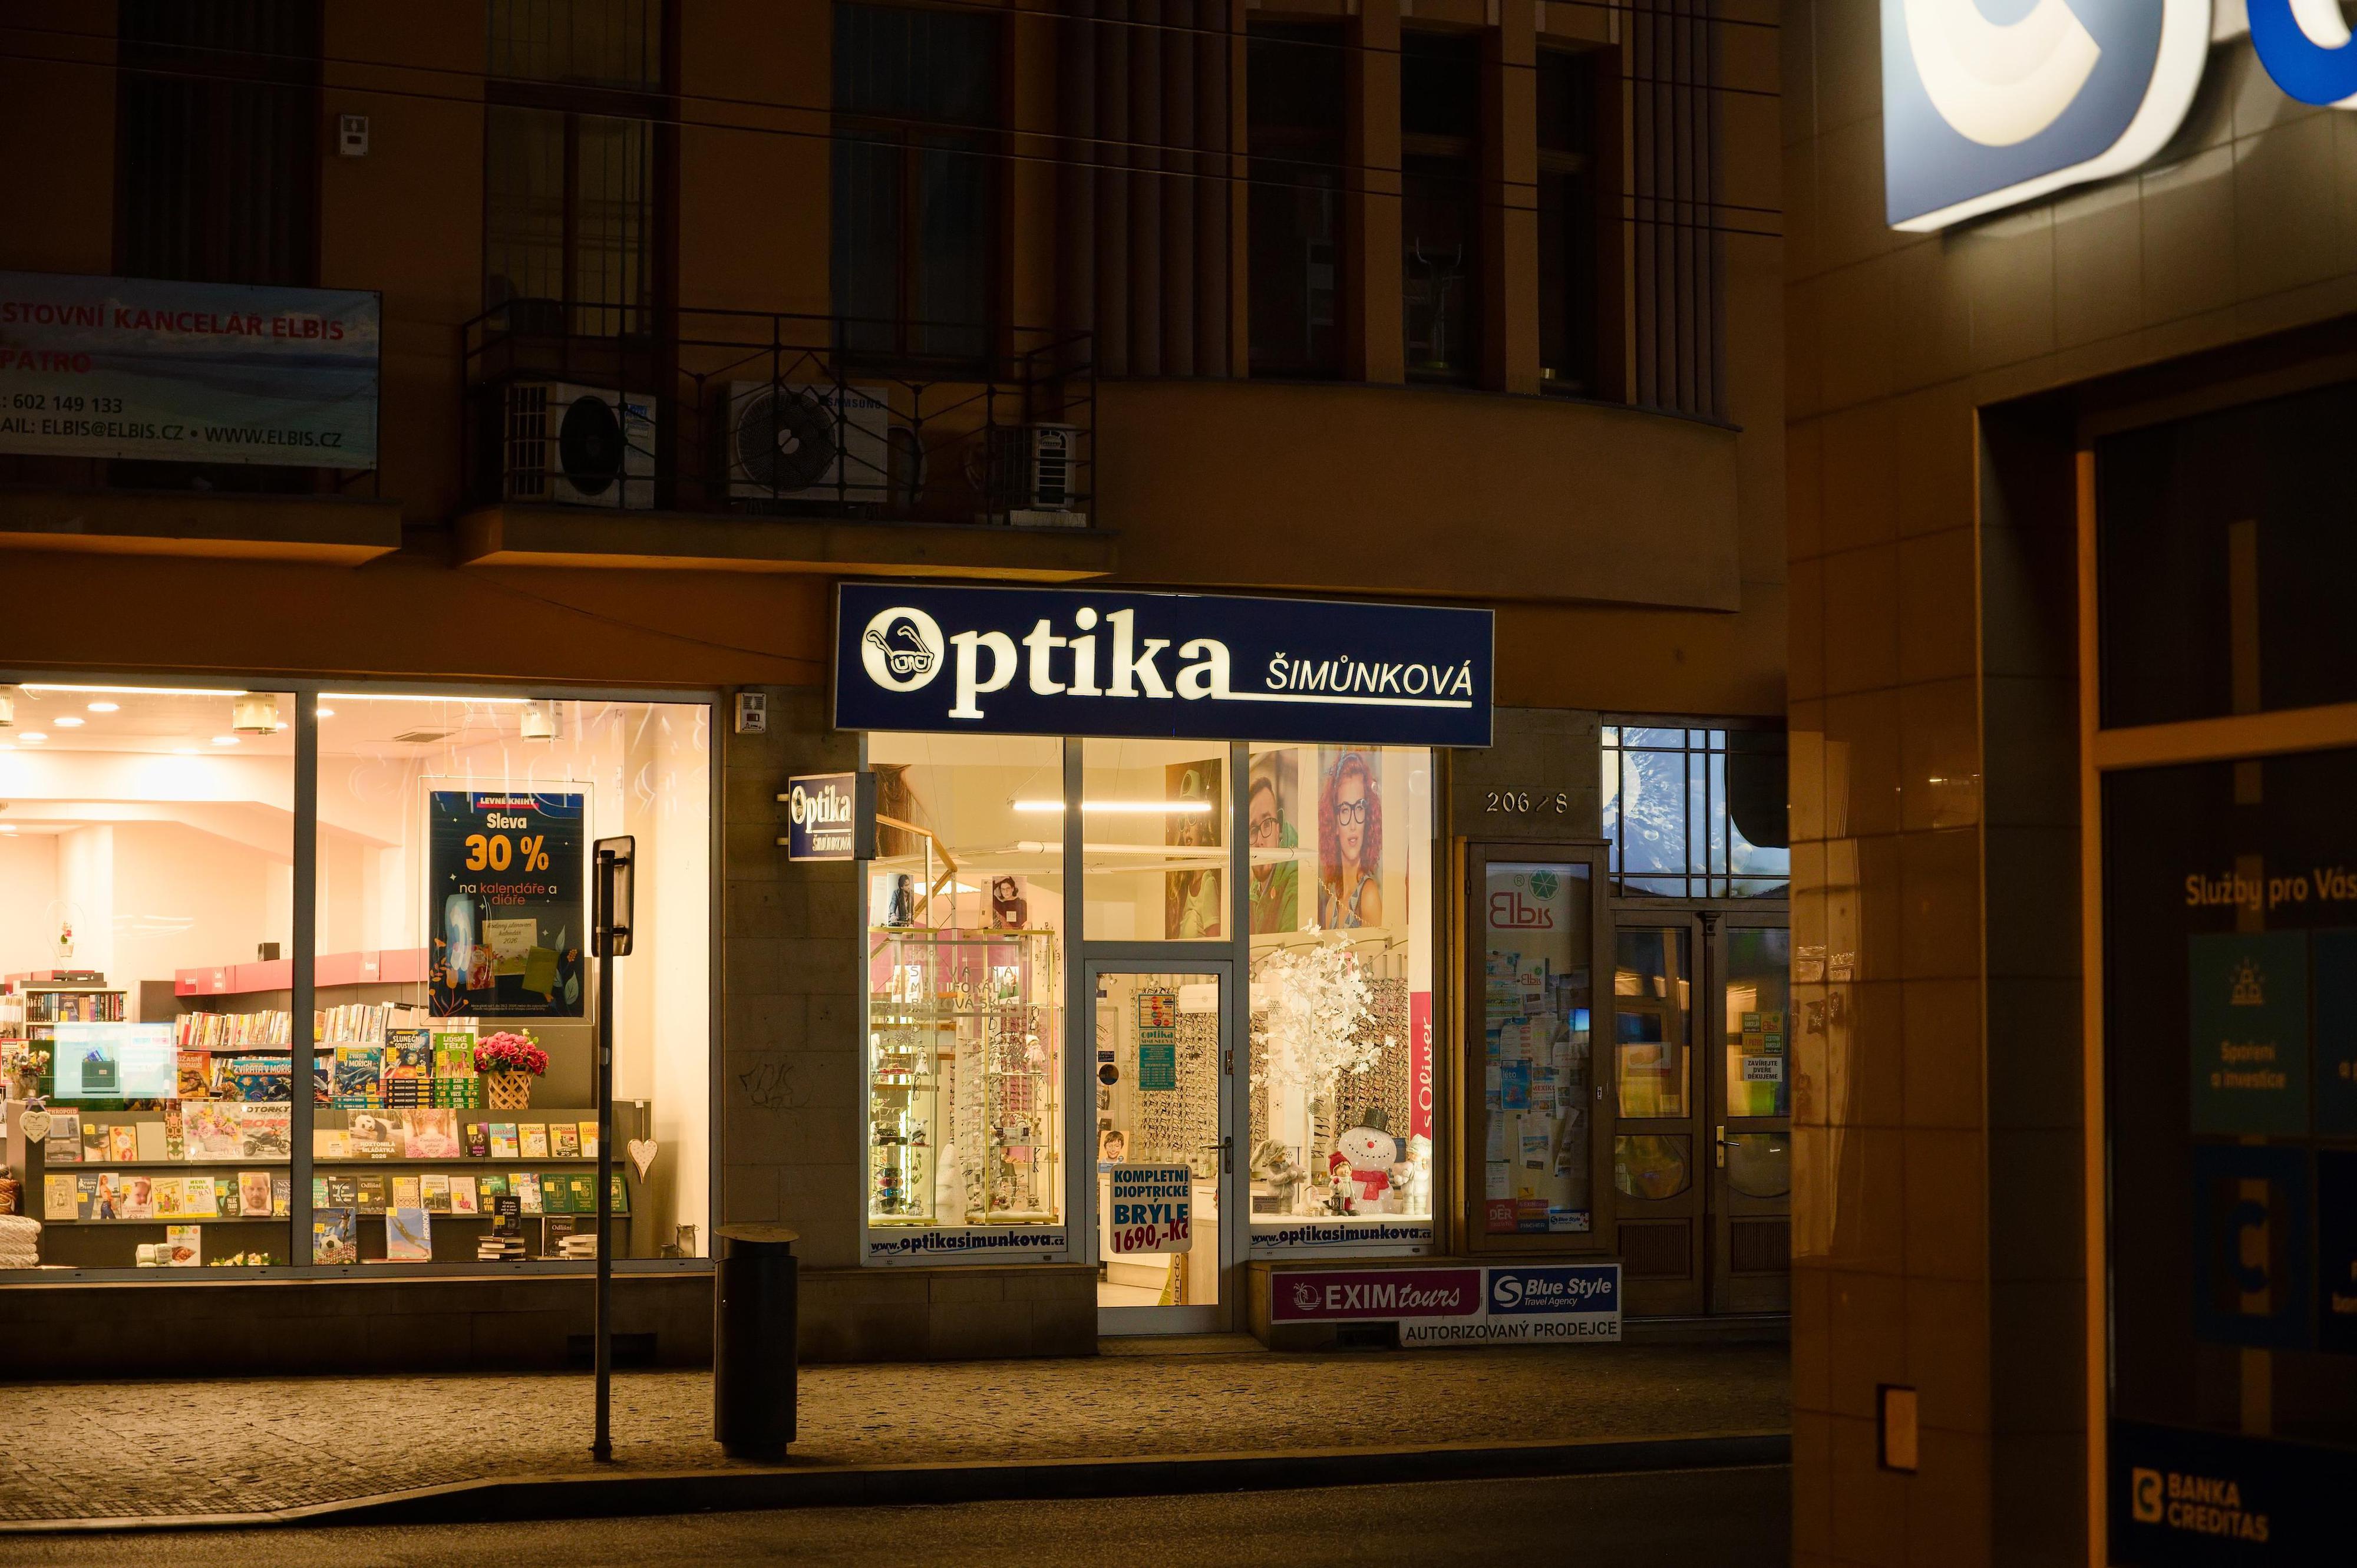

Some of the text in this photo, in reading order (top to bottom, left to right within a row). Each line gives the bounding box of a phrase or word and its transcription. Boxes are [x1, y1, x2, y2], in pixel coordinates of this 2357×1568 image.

[115, 307, 263, 336] KANCELÁŘ
[273, 317, 345, 340] ELBIS
[0, 349, 92, 373] PATRO
[13, 394, 123, 413] 602 149 133
[41, 418, 184, 441] ELBIS@ELBIS.CZ
[205, 426, 342, 448] WWW.ELBIS.CZ
[861, 606, 1473, 719] Optika ŠIMŮNKOVÁ
[480, 796, 536, 806] LEVNÉ KNIHY
[791, 784, 852, 834] Optika
[487, 813, 527, 829] Sleva
[812, 833, 851, 851] ŠIMŮNKOVÁ
[465, 834, 549, 872] 30 %
[460, 883, 557, 894] na kalendáře a
[2184, 870, 2264, 911] Služby
[2268, 876, 2310, 911] pro
[492, 894, 526, 905] diáře
[1490, 892, 1553, 929] Elbis
[392, 1034, 422, 1042] SLUNEČNÍ
[1141, 1030, 1173, 1038] optika
[242, 1120, 288, 1128] 2026
[1114, 1166, 1189, 1183] KOMPLETNÍ
[1114, 1182, 1189, 1198] DIOPTRICKÉ
[1114, 1198, 1189, 1224] BRÝLE
[870, 1231, 1065, 1253] www.optikasimunkova.cz
[1114, 1216, 1189, 1253] 1690,-Kč
[1251, 1224, 1432, 1245] www.optikasimunkova.cz
[1525, 1278, 1565, 1296] Blue
[1569, 1275, 1612, 1300] Style
[1524, 1296, 1578, 1307] Travel Agency
[1406, 1320, 1617, 1341] AUTORIZOVANÝ PRODEJCE
[2166, 1471, 2242, 1508] BANKA
[2167, 1502, 2272, 1544] CREDITAS
